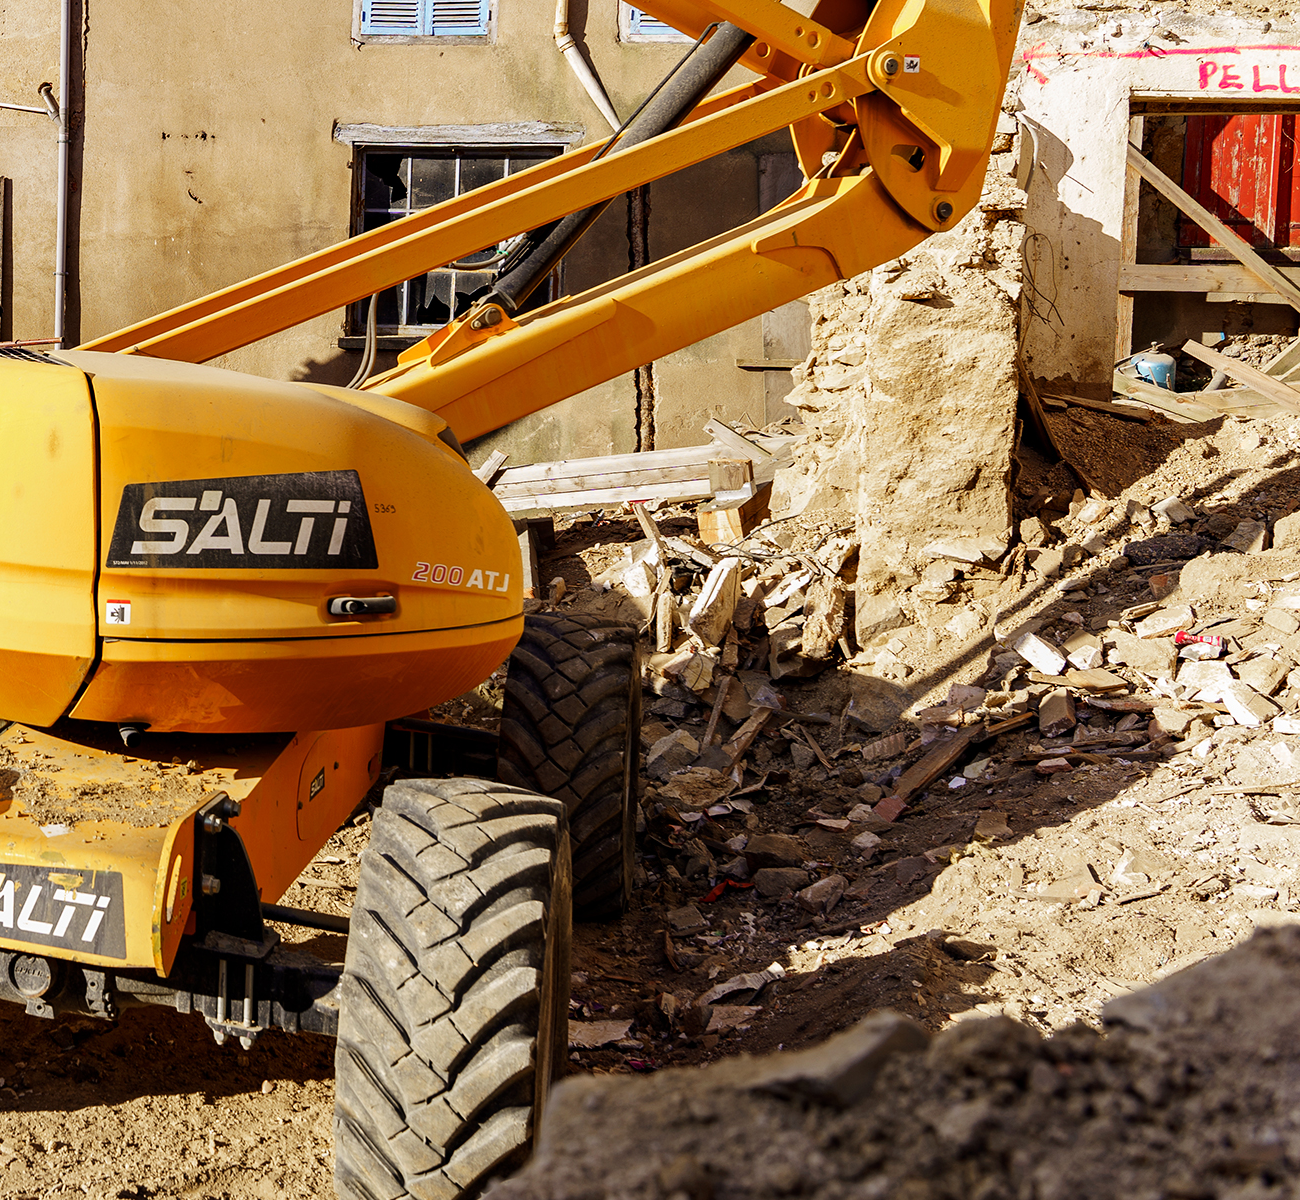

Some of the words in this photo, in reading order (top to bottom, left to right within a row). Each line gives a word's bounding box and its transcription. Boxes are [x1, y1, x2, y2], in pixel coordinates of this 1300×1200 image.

[1198, 61, 1300, 93] PELL
[373, 503, 397, 514] 5369
[411, 561, 464, 586] 200
[465, 568, 510, 593] ATJ
